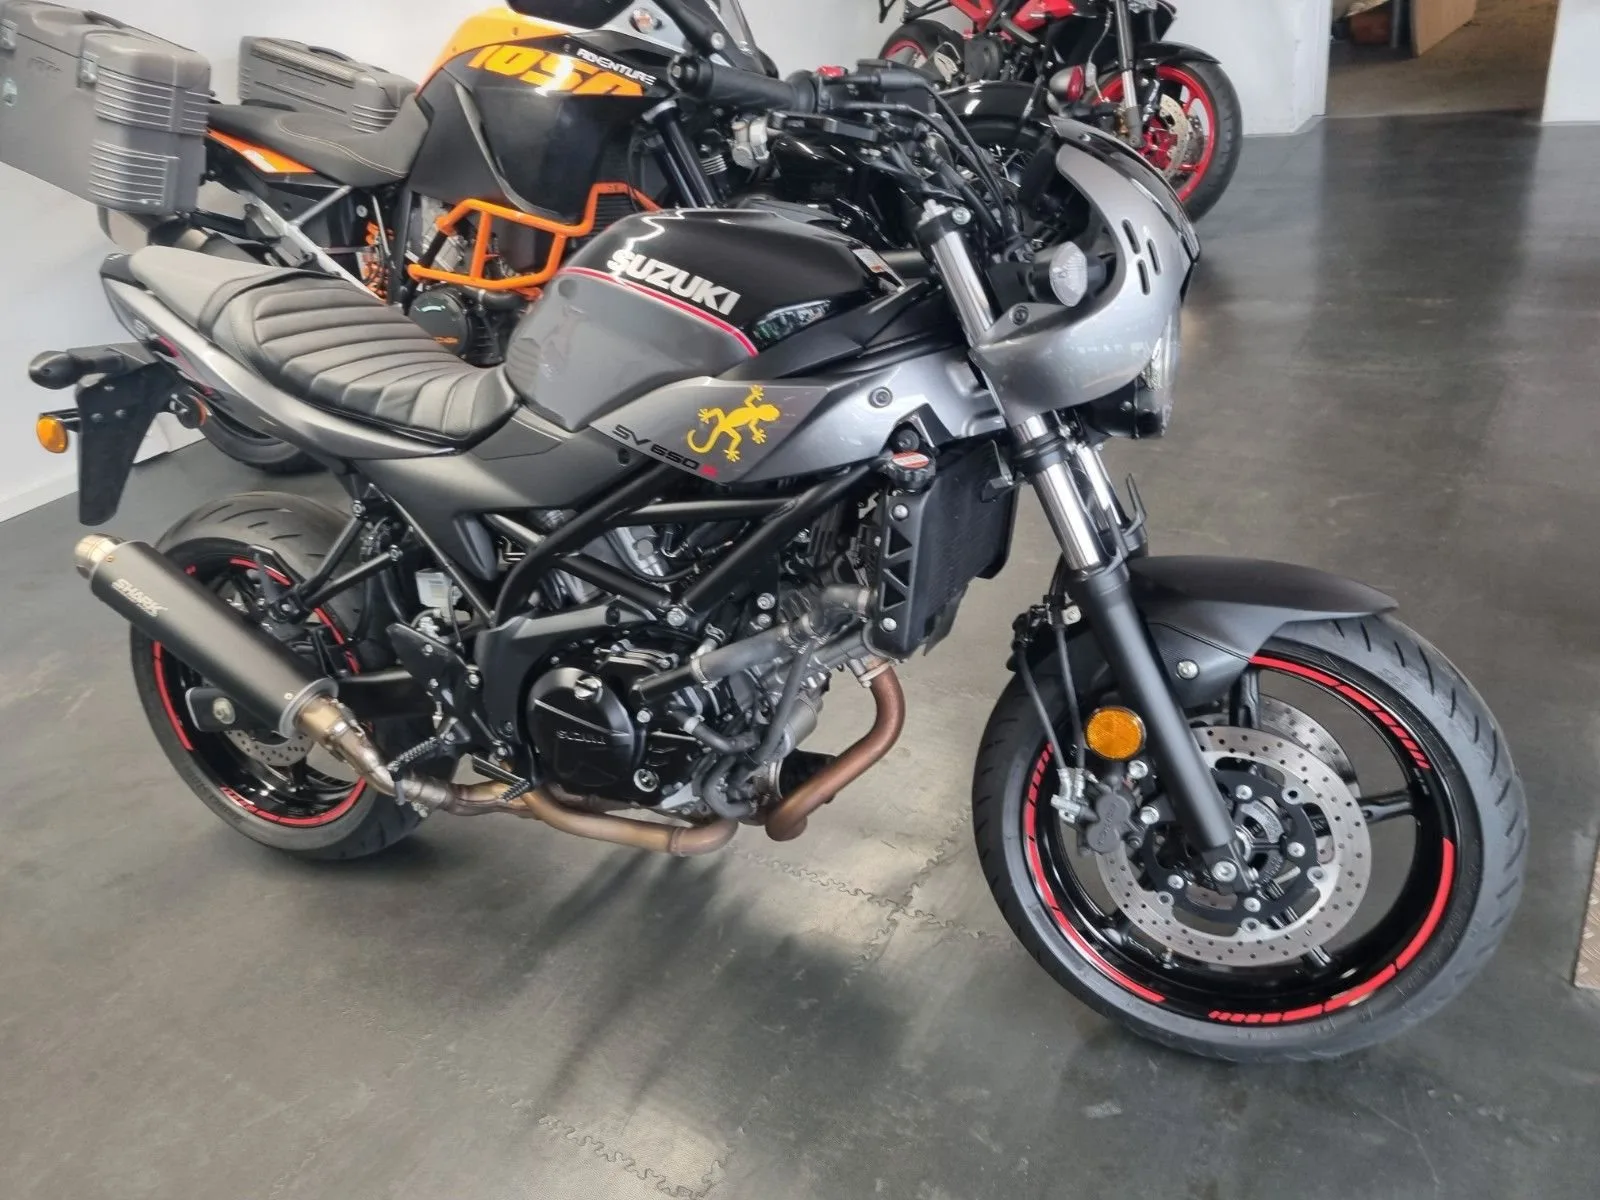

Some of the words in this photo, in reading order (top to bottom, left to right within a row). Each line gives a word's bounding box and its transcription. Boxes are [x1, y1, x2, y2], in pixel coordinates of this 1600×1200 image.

[467, 44, 643, 96] 1050
[576, 47, 657, 86] ADVENTURE
[606, 248, 741, 316] SUZUKI
[111, 578, 168, 617] SHARK
